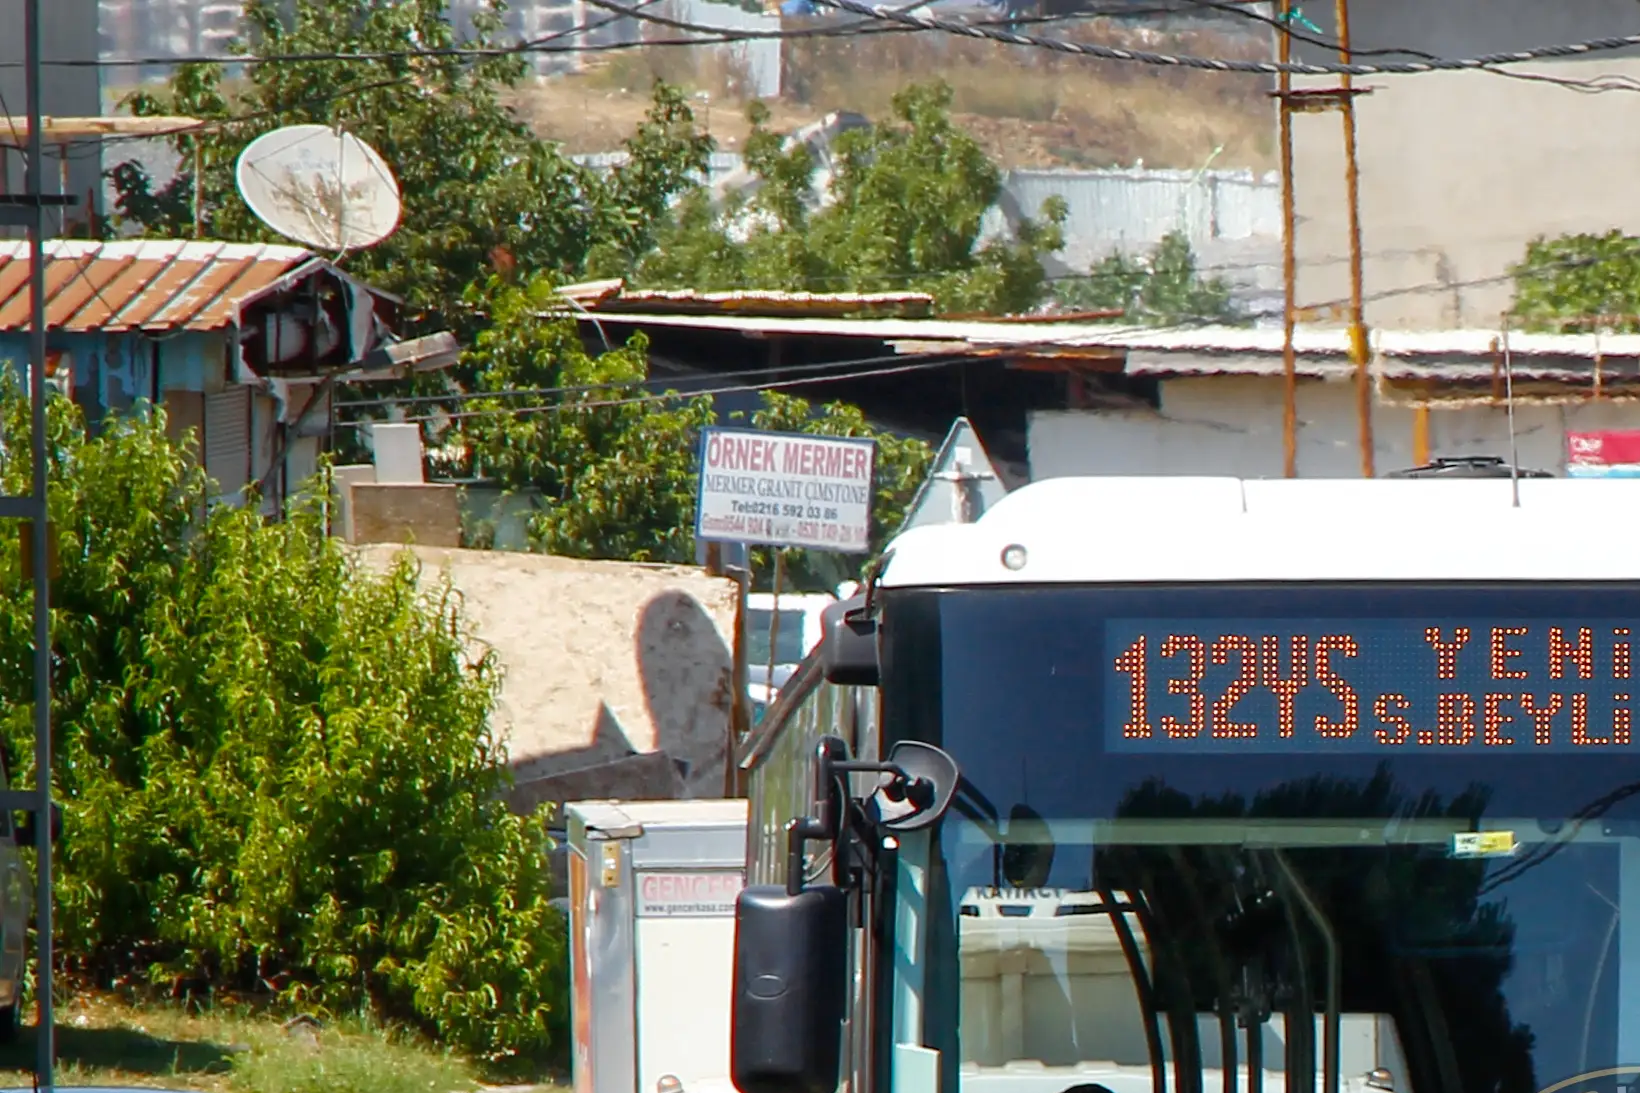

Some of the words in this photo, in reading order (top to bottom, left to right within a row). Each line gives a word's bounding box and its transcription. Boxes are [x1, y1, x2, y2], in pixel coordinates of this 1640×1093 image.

[707, 432, 778, 473] ÖRNEK
[783, 442, 867, 480] MERMER
[705, 474, 755, 495] MERMER
[782, 504, 801, 519] 592
[1114, 635, 1358, 738] 132YS
